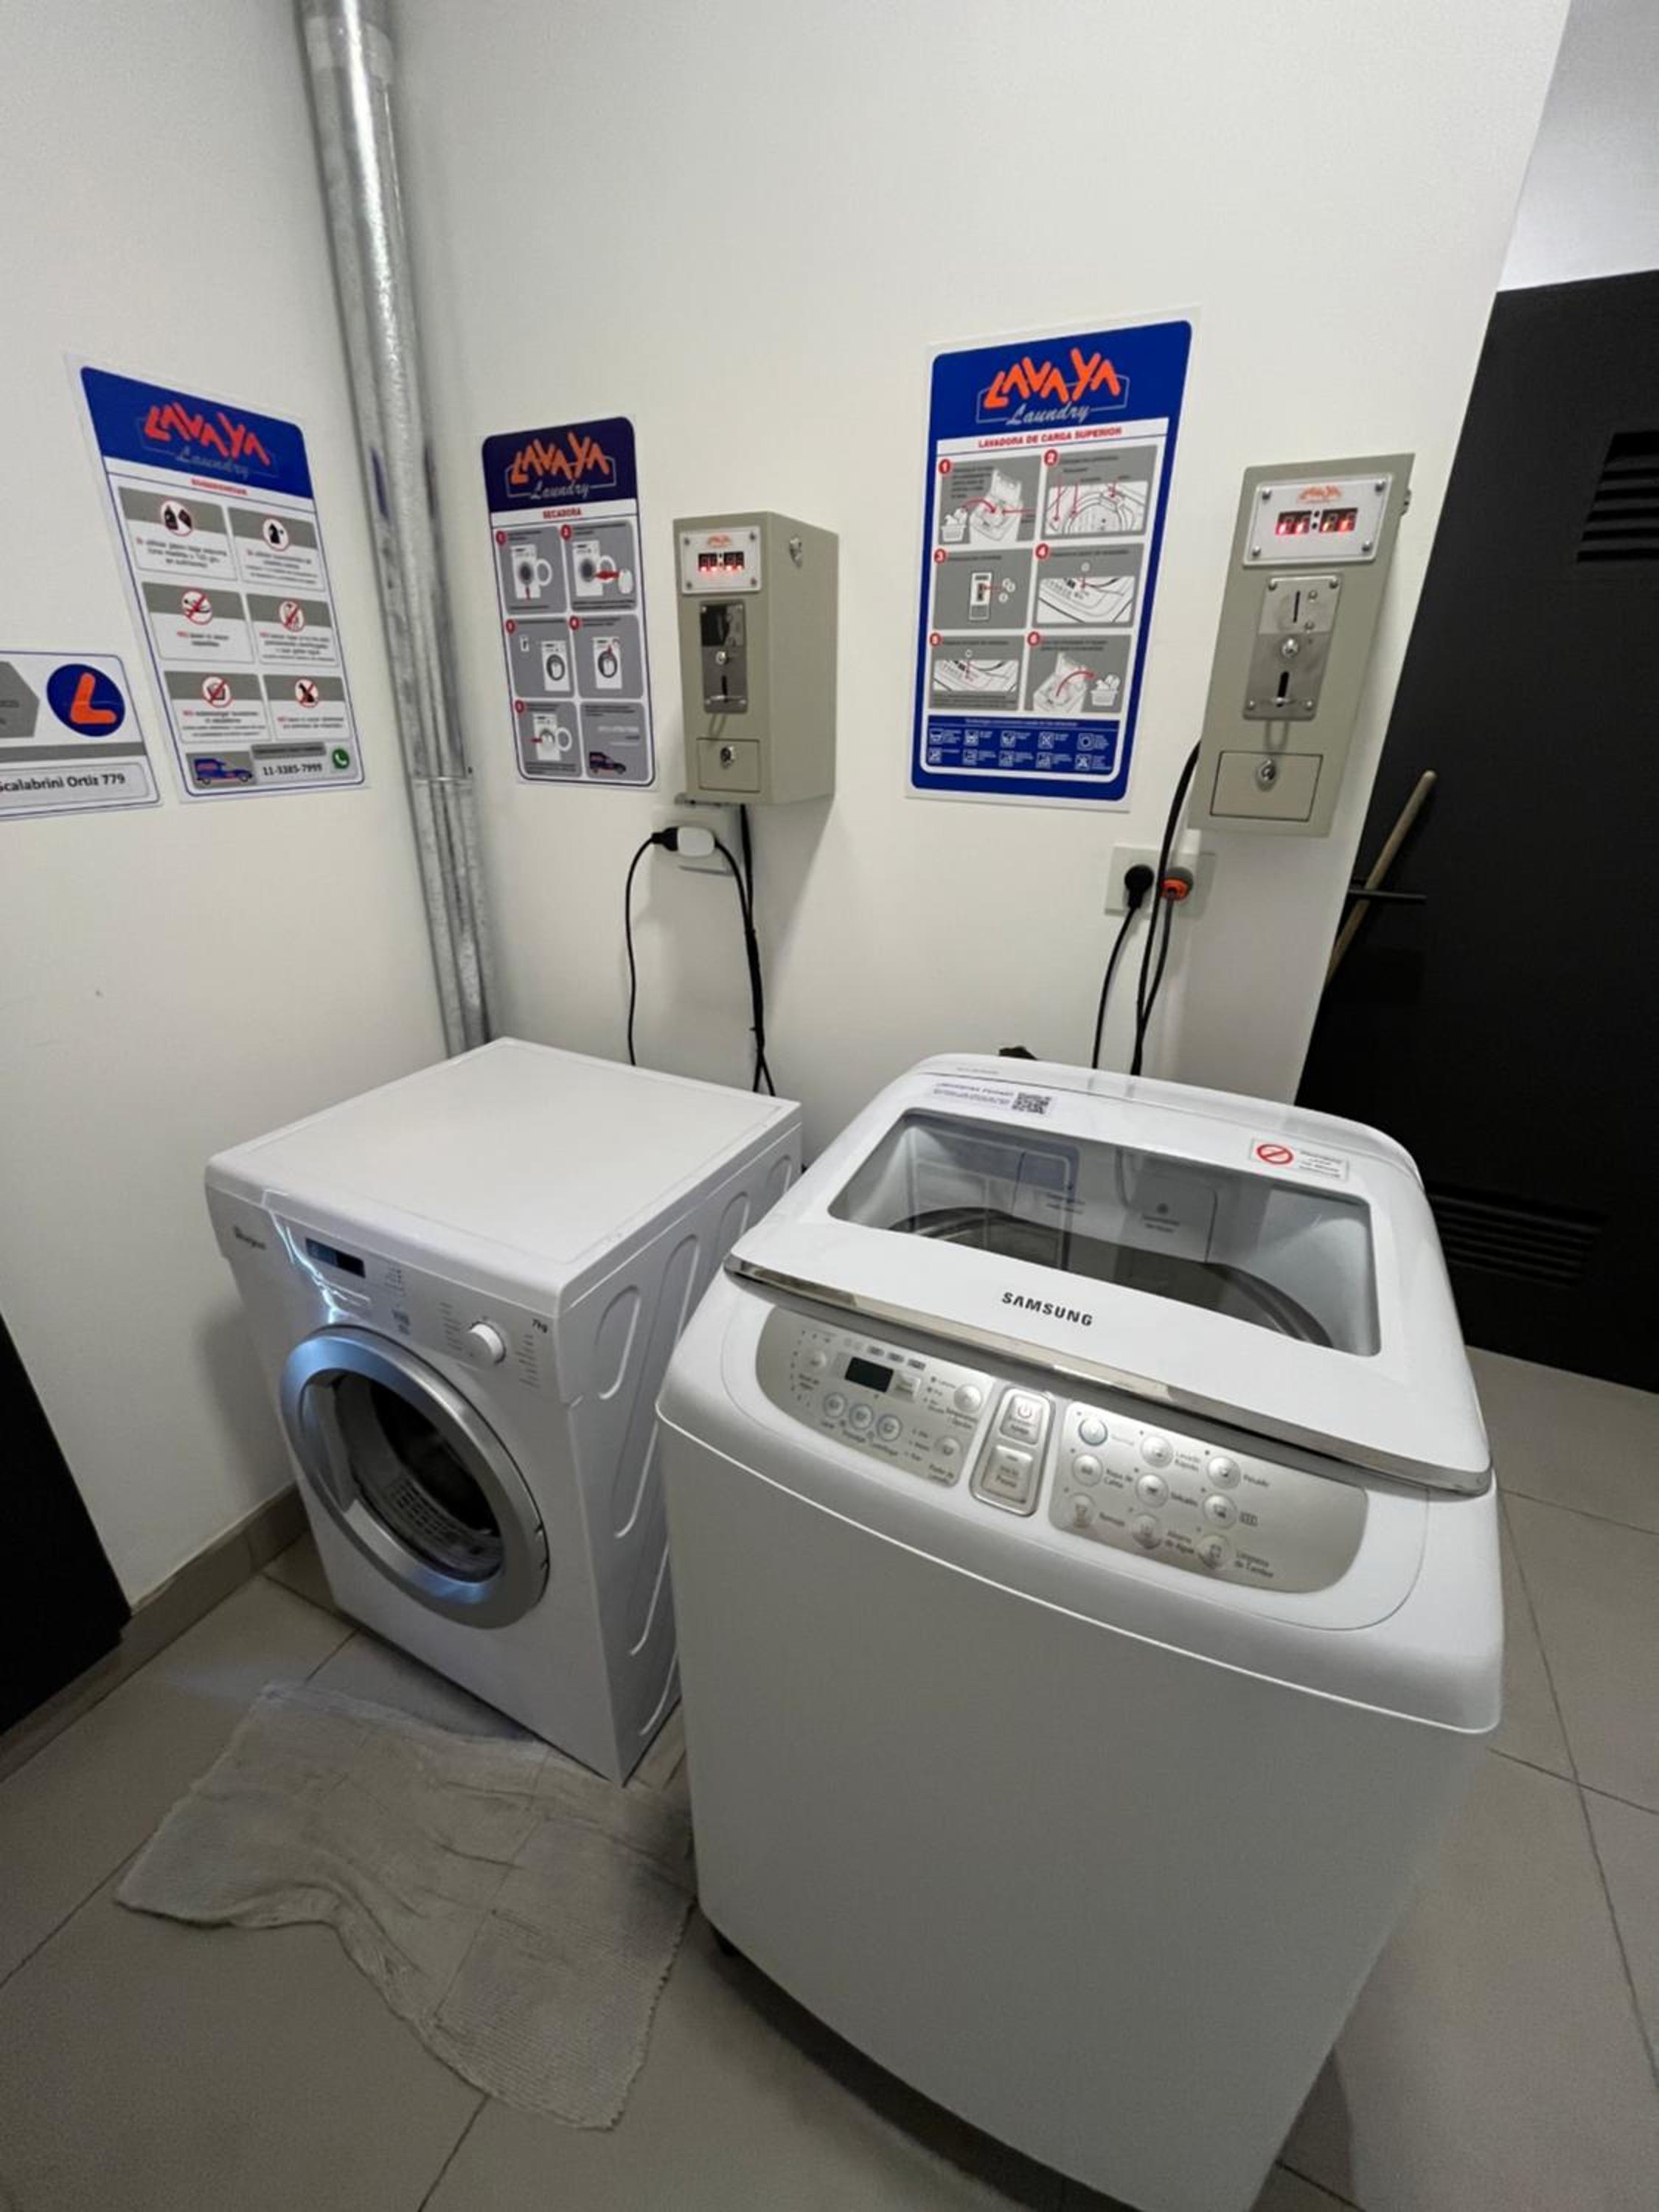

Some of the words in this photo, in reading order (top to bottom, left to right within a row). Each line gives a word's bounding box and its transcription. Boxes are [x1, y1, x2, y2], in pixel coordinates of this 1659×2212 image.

[1005, 402, 1090, 425] Laundry
[978, 436, 1023, 448] LAVADORA
[1026, 435, 1038, 444] DE
[1041, 431, 1071, 442] CARGA
[1075, 427, 1122, 440] SUPERIOR
[530, 480, 590, 500] Laundry
[67, 774, 100, 787] Ortiz
[100, 773, 125, 785] 779
[1001, 1291, 1093, 1326] SAMSUNG
